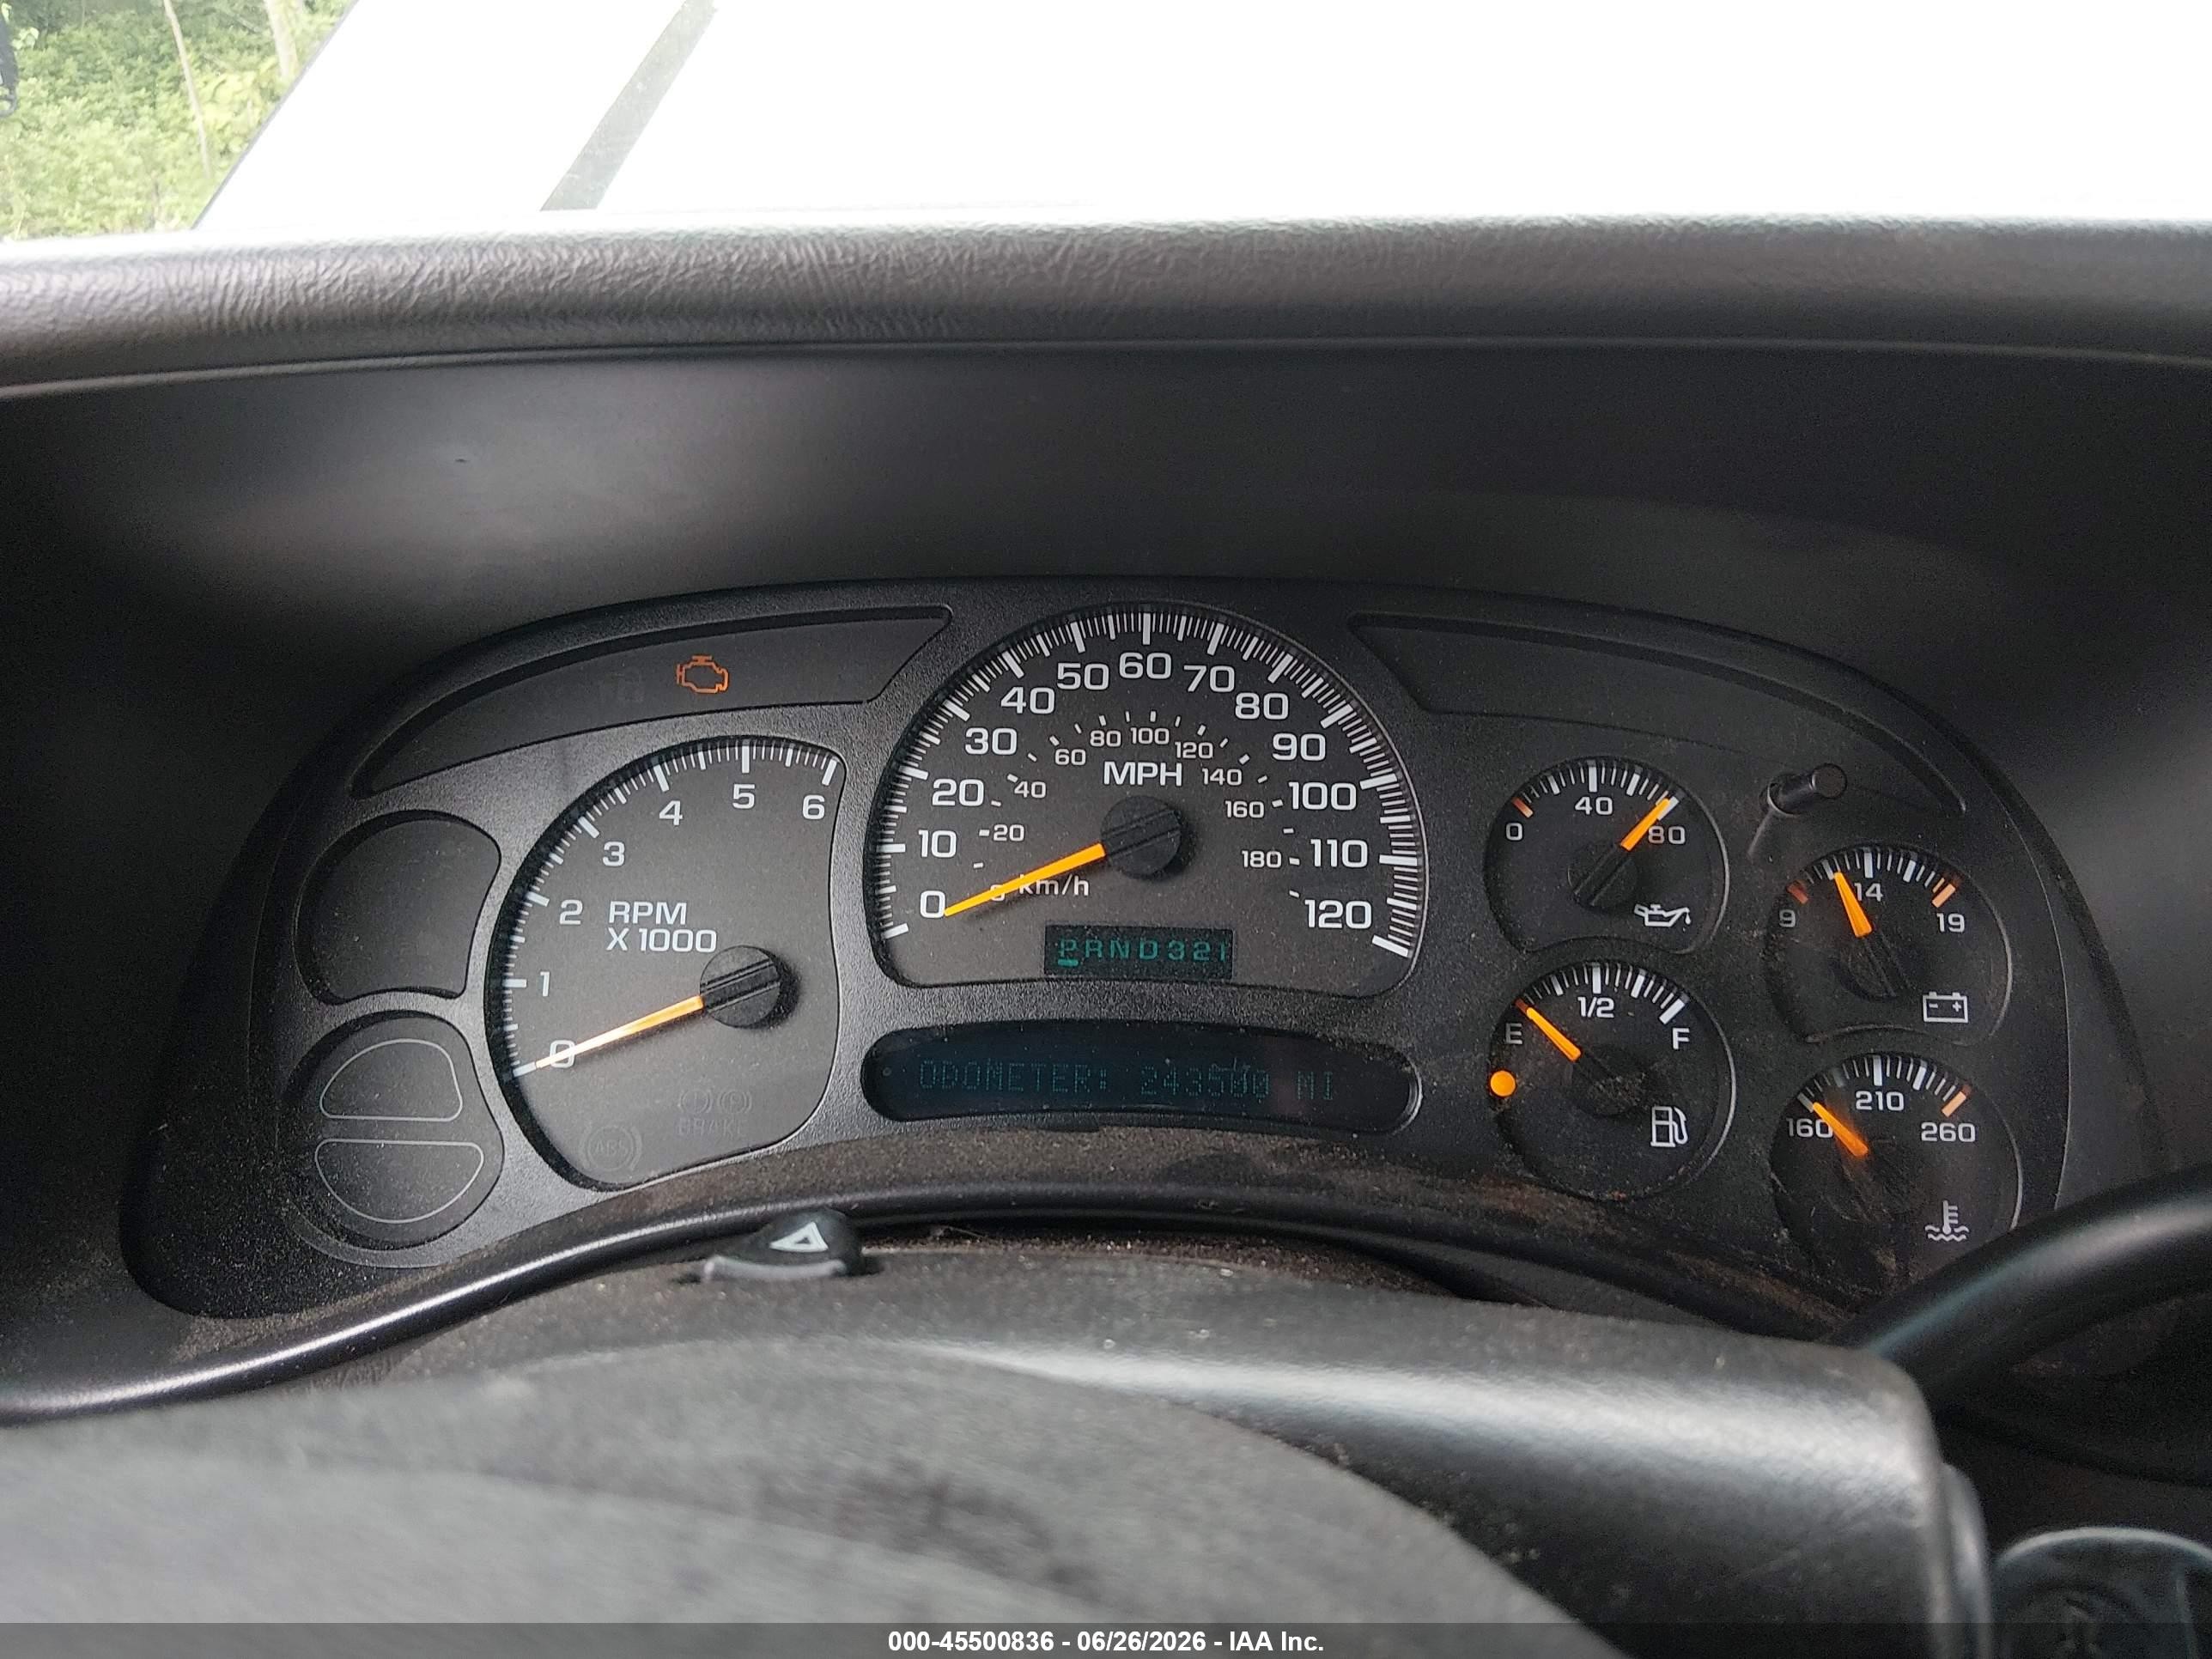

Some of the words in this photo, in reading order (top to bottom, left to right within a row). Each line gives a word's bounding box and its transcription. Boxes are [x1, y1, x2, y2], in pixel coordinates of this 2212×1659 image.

[1056, 662, 1109, 690] 50
[1119, 652, 1172, 679] 60
[1183, 665, 1235, 693] 70
[1000, 686, 1055, 714] 40
[1235, 692, 1289, 720] 80
[964, 727, 1018, 756] 30
[1090, 730, 1121, 747] 80
[1130, 727, 1170, 744] 100
[1272, 732, 1326, 761] 90
[1054, 748, 1086, 766] 60
[1174, 741, 1213, 759] 120
[1103, 761, 1182, 787] MPH
[1201, 768, 1243, 786] 140
[732, 783, 756, 809] 5
[932, 778, 984, 806] 20
[1013, 780, 1047, 799] 40
[1288, 781, 1357, 811] 100
[659, 800, 684, 826] 4
[802, 794, 825, 820] 6
[1224, 800, 1265, 818] 160
[1574, 796, 1613, 815] 40
[918, 830, 957, 858] 10
[993, 823, 1024, 842] 20
[1505, 823, 1523, 841] 0
[1648, 825, 1686, 845] 80
[602, 841, 625, 866] 3
[1242, 850, 1282, 868] 180
[1310, 838, 1368, 868] 110
[1019, 874, 1090, 896] km/h
[1854, 882, 1884, 902] 14
[559, 899, 583, 925] 2
[608, 901, 687, 926] RPM
[920, 890, 946, 919] 0
[1304, 899, 1372, 929] 120
[1779, 909, 1796, 928] 9
[1936, 913, 1966, 933] 19
[607, 927, 629, 951] X
[639, 928, 716, 952] 1000
[539, 971, 550, 997] 1
[1577, 996, 1614, 1018] 1/2
[1505, 1023, 1523, 1045] E
[1672, 1027, 1690, 1050] F
[550, 1039, 575, 1068] 0
[920, 1058, 1107, 1092] ODOMETER:
[1297, 1071, 1334, 1099] MI
[1855, 1091, 1905, 1111] 210
[1787, 1118, 1833, 1139] 160
[1921, 1121, 1976, 1143] 260
